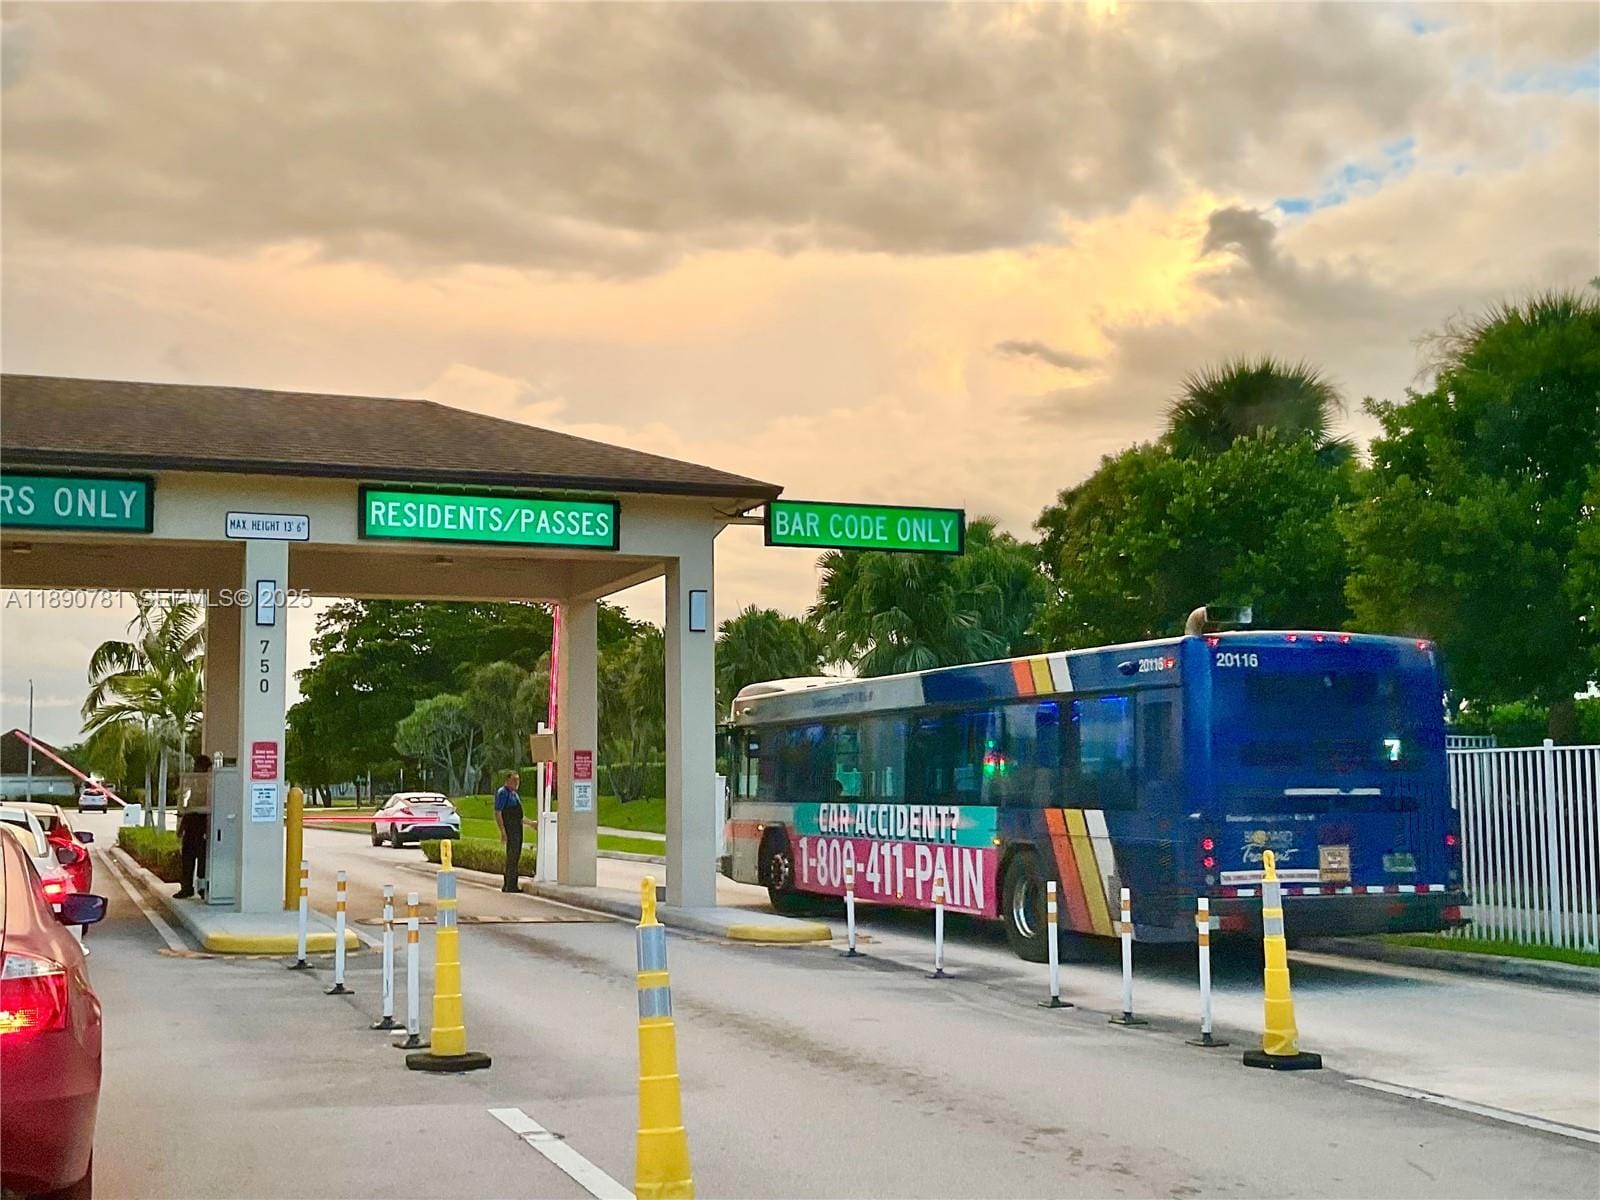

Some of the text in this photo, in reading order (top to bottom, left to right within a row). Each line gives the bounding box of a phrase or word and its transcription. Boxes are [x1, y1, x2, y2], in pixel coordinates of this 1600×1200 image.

[0, 485, 137, 519] RS ONLY
[252, 520, 280, 532] HEIGHT
[370, 500, 610, 538] RESIDENTS/PASSES
[775, 511, 954, 544] BAR CODE ONLY
[1138, 656, 1165, 673] 20116
[1216, 652, 1259, 668] 20116
[1383, 738, 1401, 761] 7
[819, 802, 960, 842] CAR ACCIDENT?
